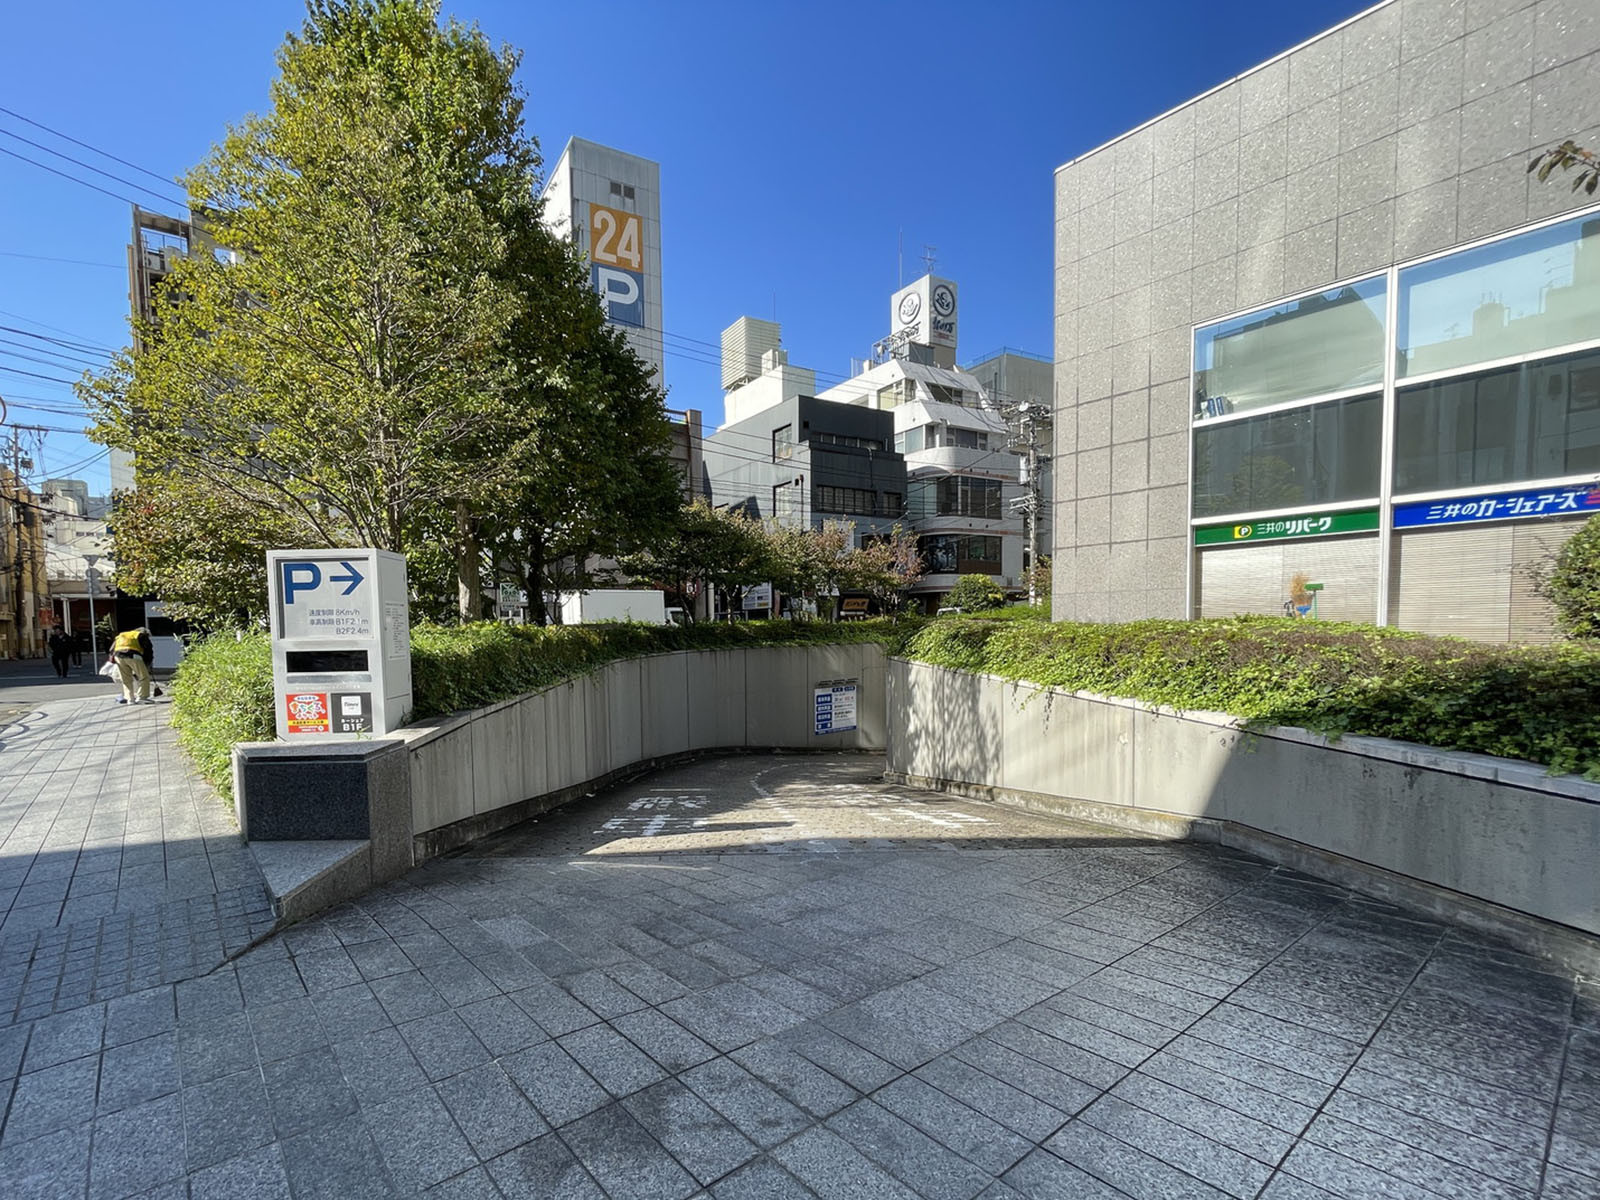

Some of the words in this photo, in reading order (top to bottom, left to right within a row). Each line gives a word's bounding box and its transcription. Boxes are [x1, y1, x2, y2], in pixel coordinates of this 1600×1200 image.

[593, 209, 641, 269] 24
[598, 267, 639, 320] P
[1425, 491, 1587, 519] 三井のカーシェアーズ
[1256, 516, 1332, 535] 三井のリパーク
[283, 563, 322, 604] P
[342, 723, 363, 731] B1F
